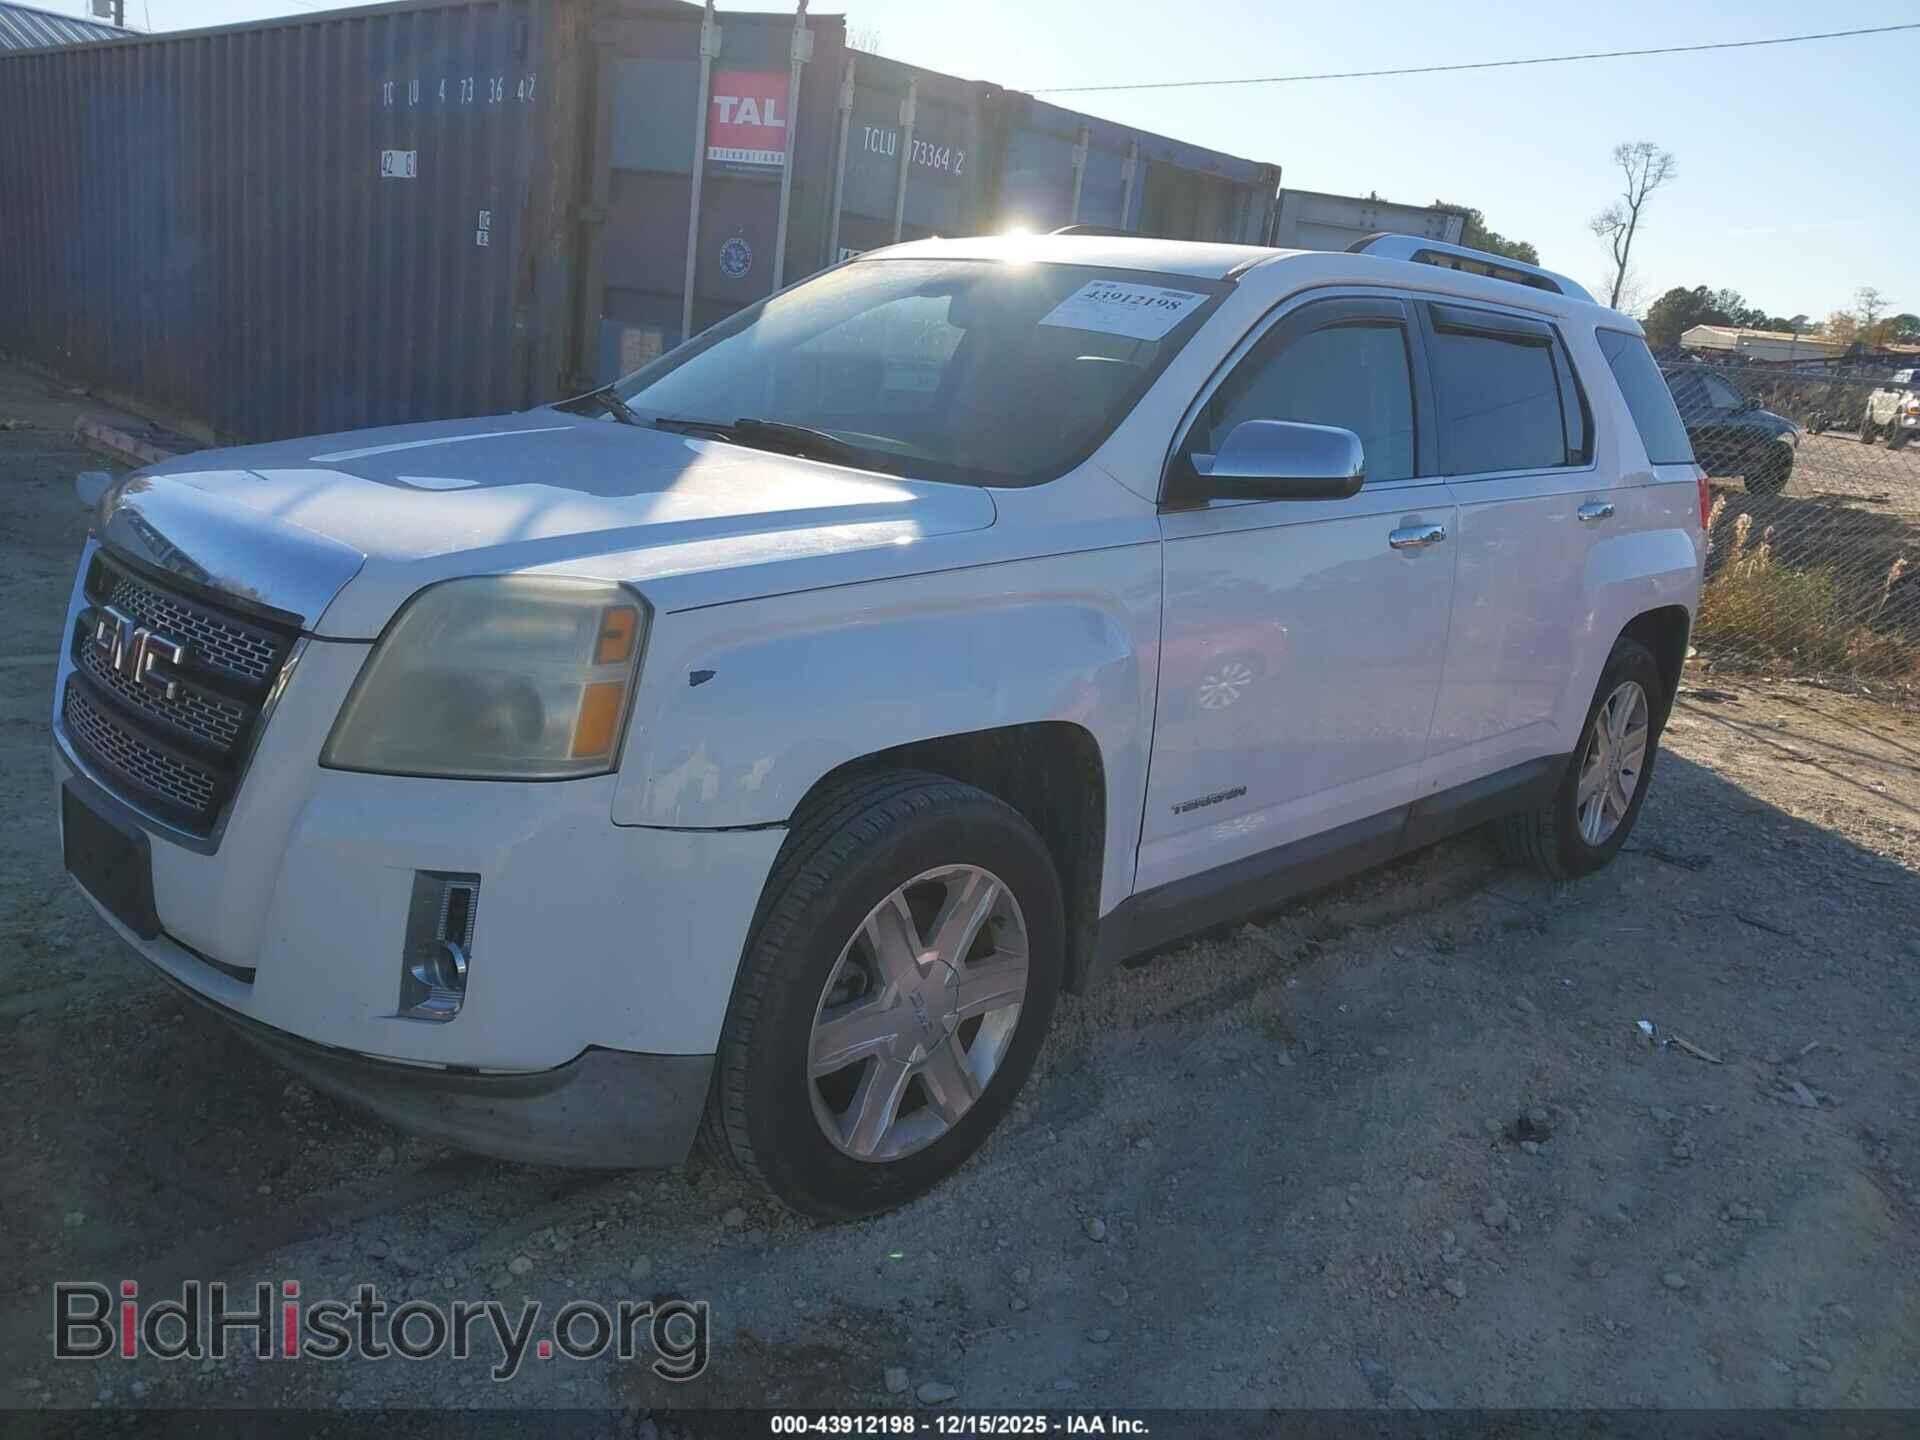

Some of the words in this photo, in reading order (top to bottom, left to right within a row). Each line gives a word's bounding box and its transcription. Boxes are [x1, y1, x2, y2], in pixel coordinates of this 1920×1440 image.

[713, 95, 785, 128] TAL
[863, 126, 896, 156] TCLU
[1085, 289, 1184, 311] 43912198
[96, 605, 182, 699] GMC
